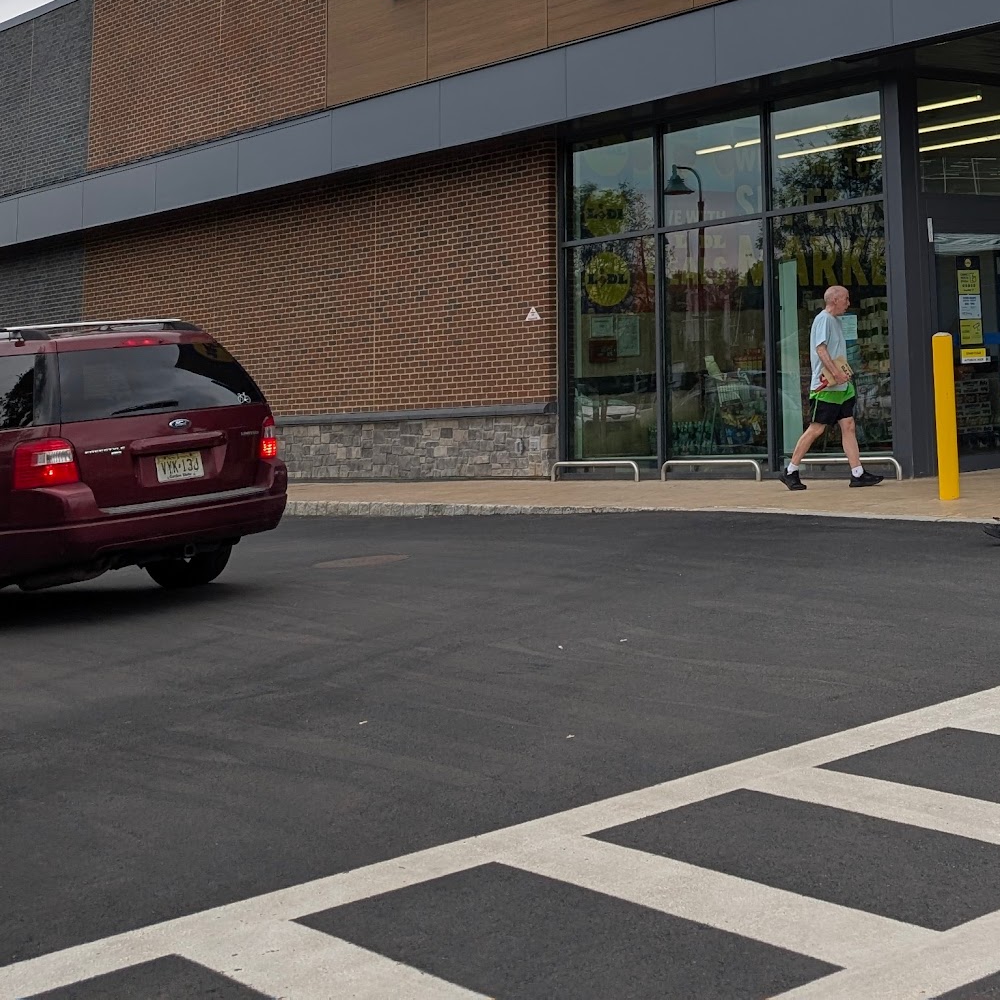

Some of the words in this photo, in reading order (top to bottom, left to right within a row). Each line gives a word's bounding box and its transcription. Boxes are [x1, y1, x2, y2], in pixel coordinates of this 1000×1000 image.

[690, 209, 727, 224] WTH
[675, 234, 727, 249] LDL
[737, 235, 889, 286] MARKE
